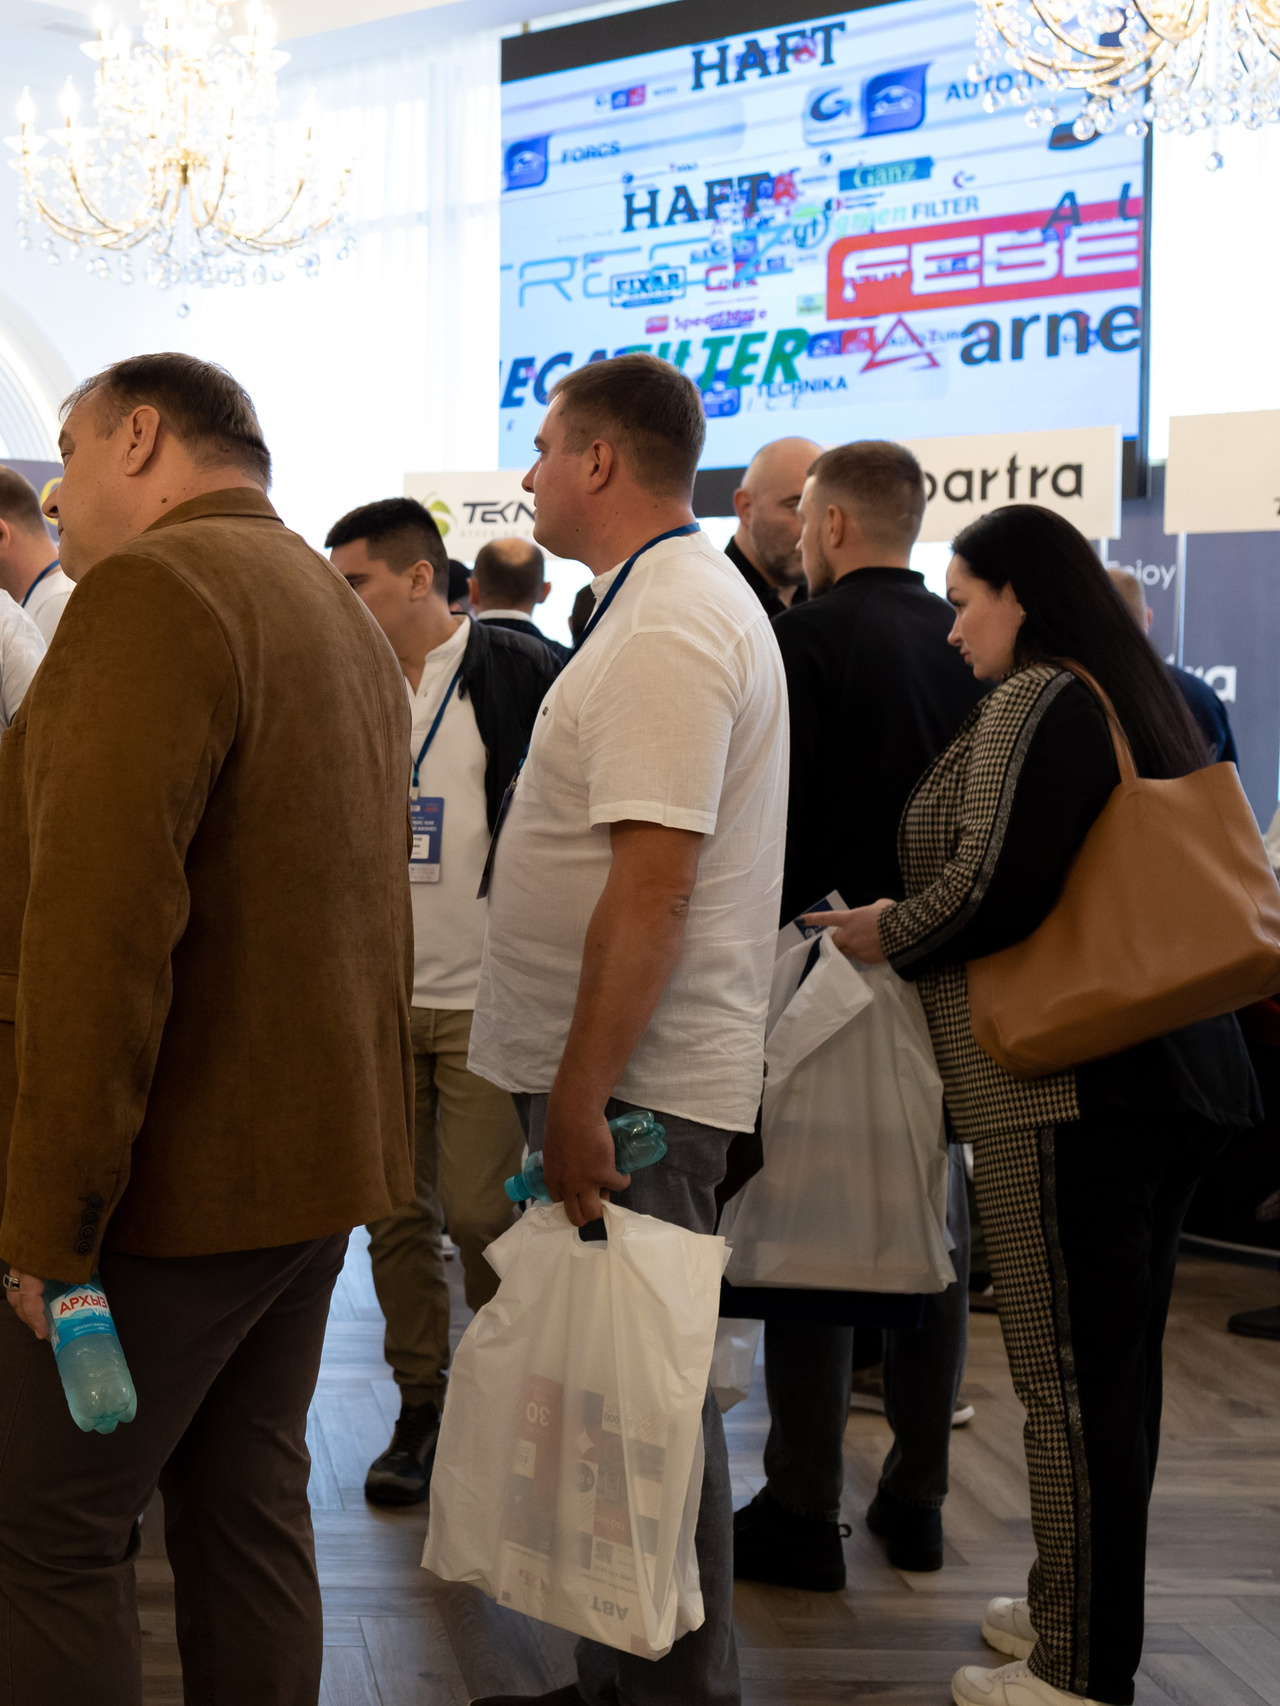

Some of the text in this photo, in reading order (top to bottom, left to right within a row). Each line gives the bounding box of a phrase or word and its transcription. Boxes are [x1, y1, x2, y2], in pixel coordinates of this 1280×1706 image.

[691, 21, 845, 91] HAFT
[853, 161, 917, 189] Ganz
[622, 172, 770, 233] HAFT
[912, 195, 980, 221] FILTER
[60, 1294, 107, 1315] АРХЫЗ
